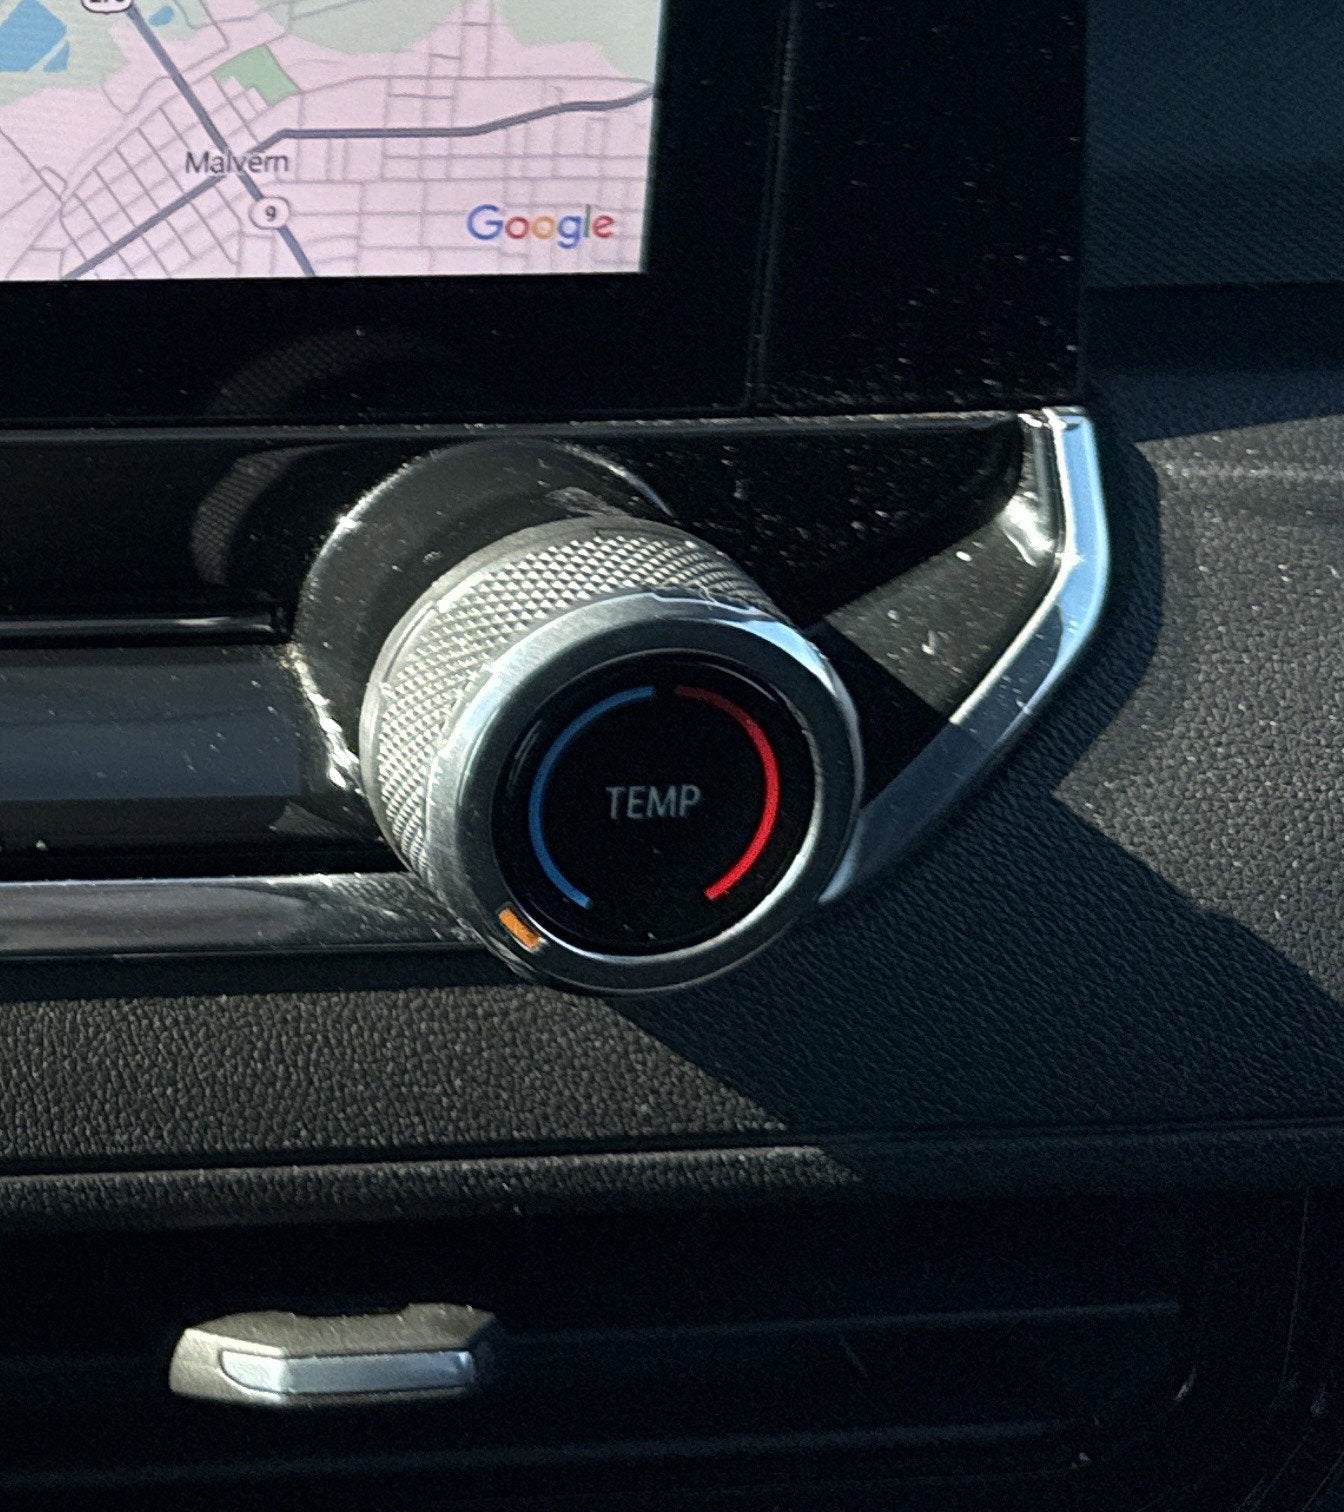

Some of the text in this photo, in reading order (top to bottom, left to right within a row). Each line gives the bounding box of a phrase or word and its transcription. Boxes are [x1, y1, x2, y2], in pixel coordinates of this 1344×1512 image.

[186, 151, 289, 176] Malvern
[264, 205, 277, 222] 9
[467, 204, 615, 248] Google
[606, 786, 702, 819] TEMP
